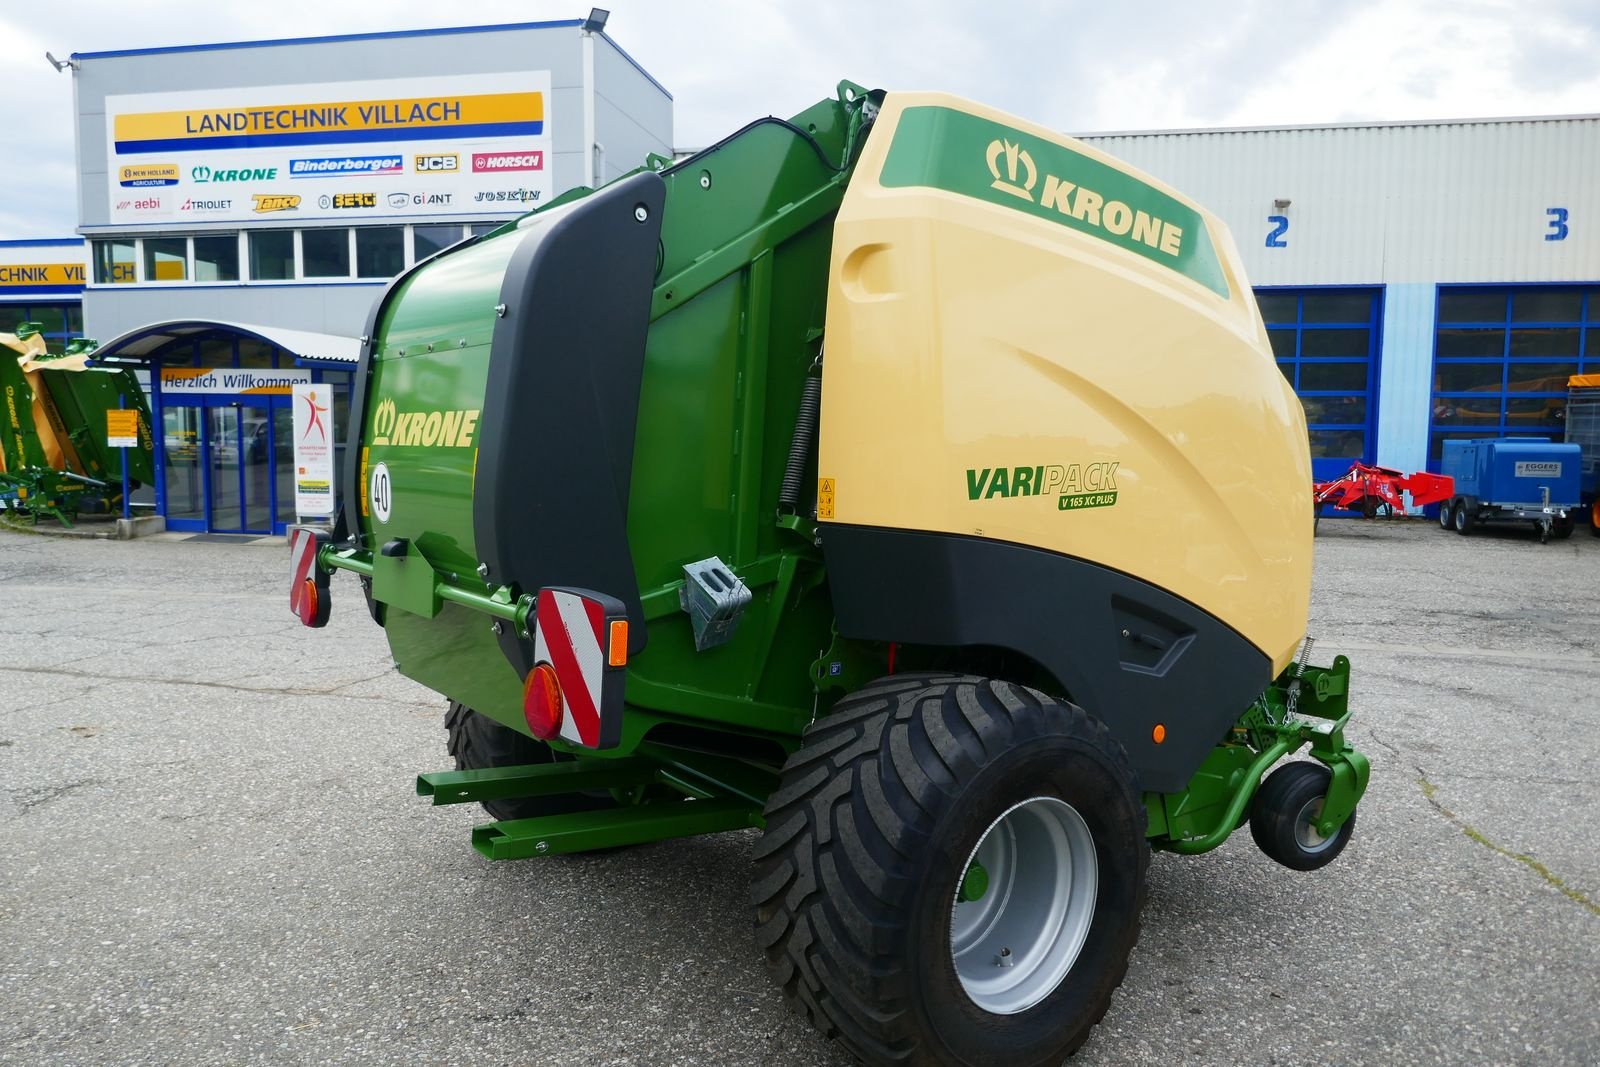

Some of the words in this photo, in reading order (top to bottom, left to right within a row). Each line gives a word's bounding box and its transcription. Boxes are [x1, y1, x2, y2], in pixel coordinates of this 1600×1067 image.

[186, 107, 348, 134] LANDTECHNIK
[359, 101, 461, 125] VILLACH
[292, 157, 400, 173] Binderberger
[417, 155, 457, 171] JCB
[487, 155, 539, 169] HORSCH
[212, 168, 278, 182] KRONE
[134, 198, 160, 210] aebi
[252, 194, 302, 213] Tanco
[474, 188, 541, 203] JOSKIN
[1040, 174, 1183, 257] KRONE
[1545, 207, 1569, 241] 3
[1265, 215, 1289, 248] 2
[164, 373, 217, 389] Herzlich
[391, 409, 480, 448] KRONE
[966, 461, 1120, 501] VARIPACK
[374, 472, 388, 513] 40
[1062, 498, 1069, 508] V
[1070, 497, 1083, 507] 165
[1084, 495, 1096, 506] XC
[1096, 494, 1114, 505] PLUS
